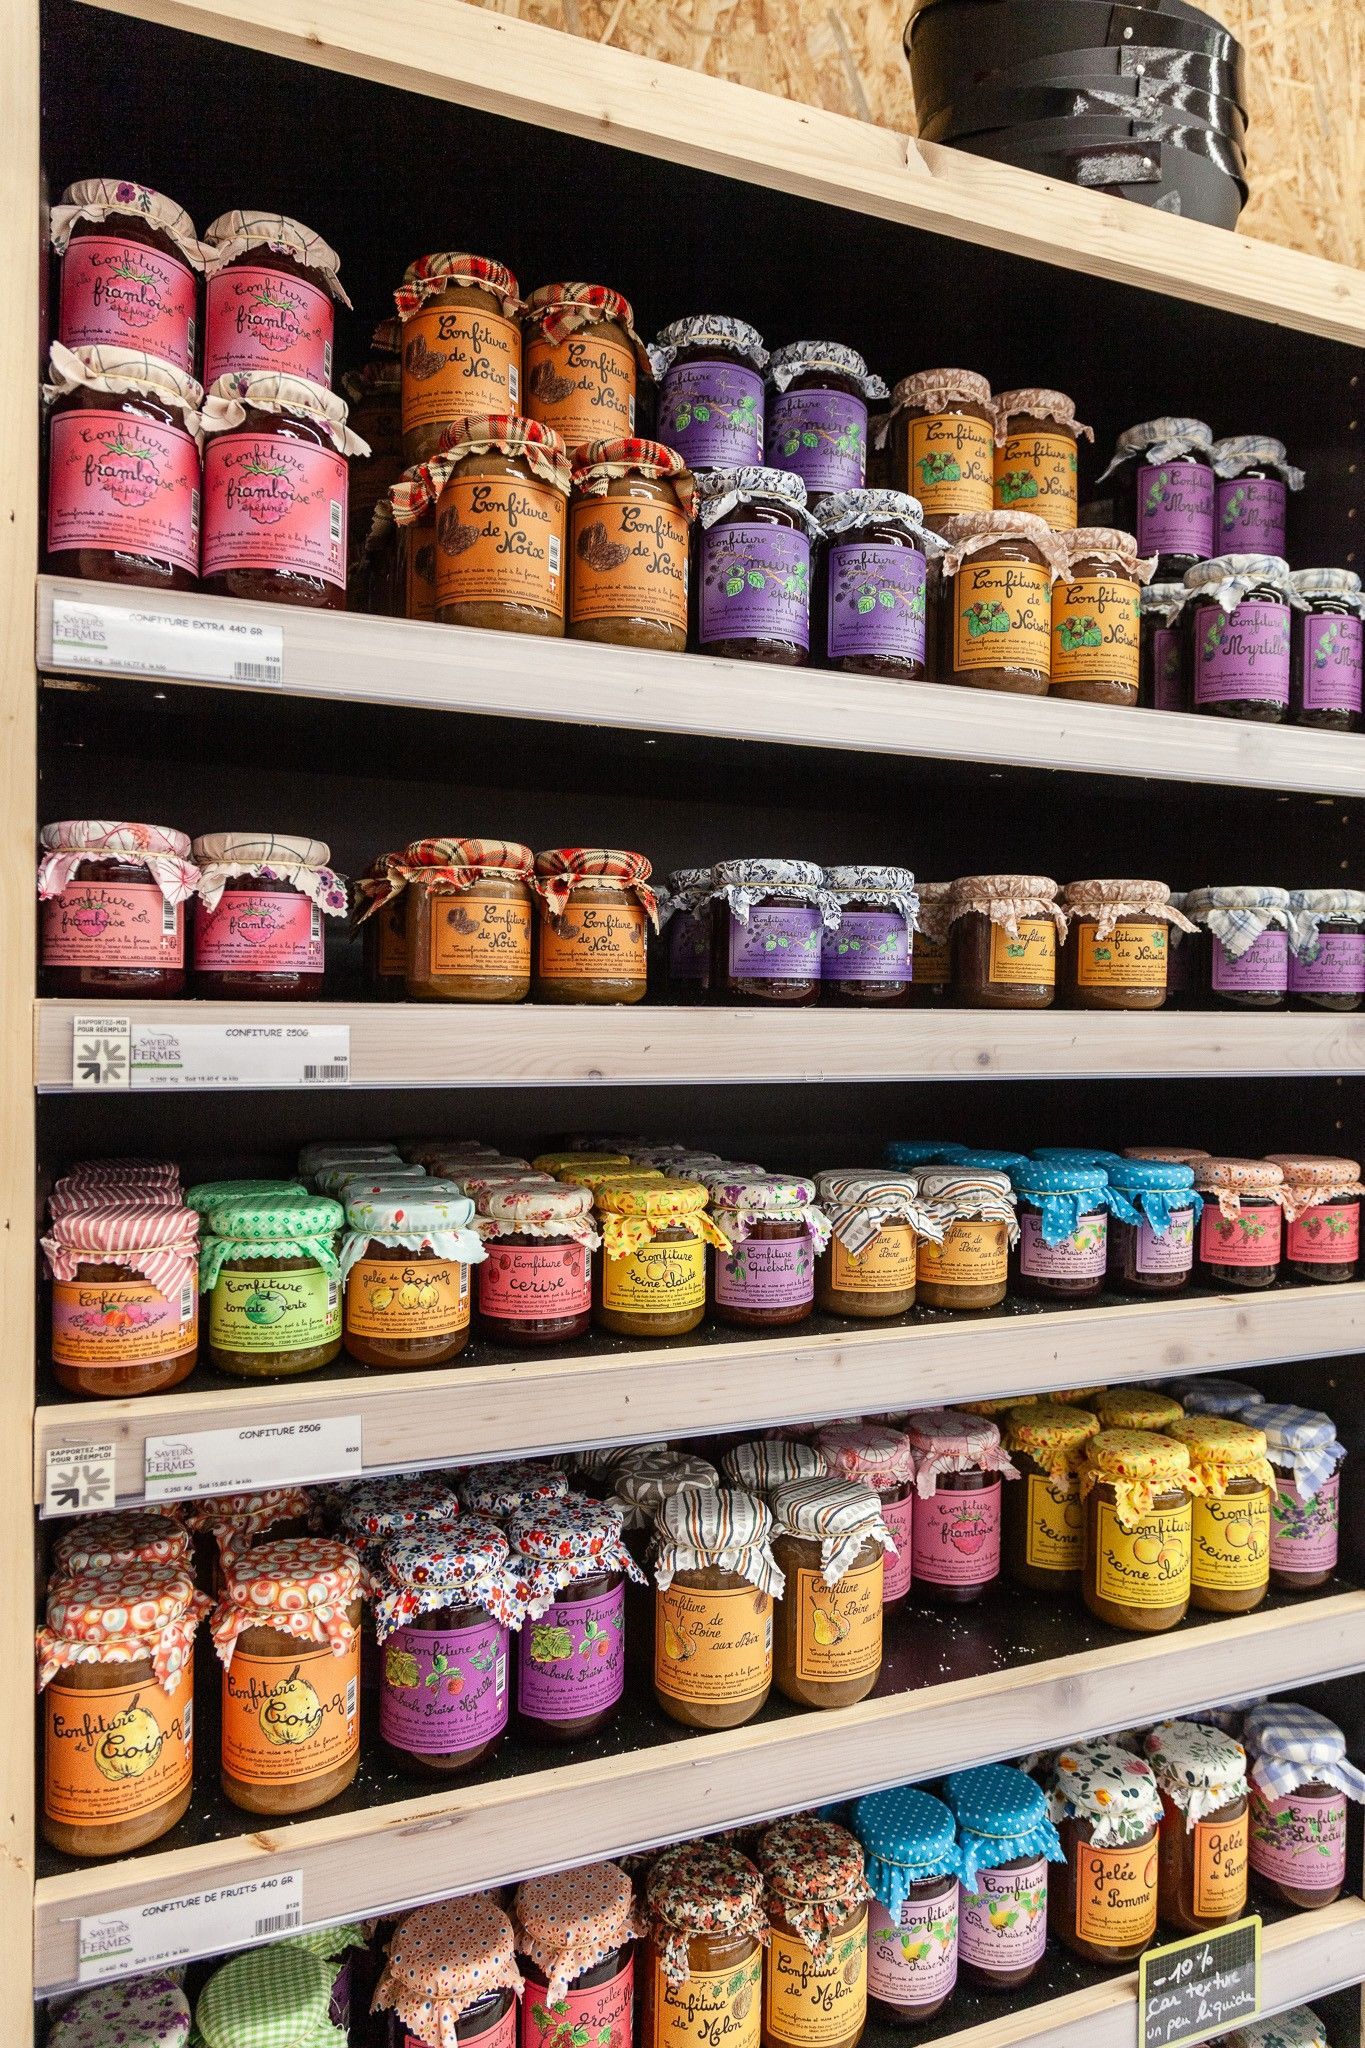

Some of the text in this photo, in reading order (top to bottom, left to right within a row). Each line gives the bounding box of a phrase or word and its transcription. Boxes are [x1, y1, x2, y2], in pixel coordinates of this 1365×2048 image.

[89, 250, 171, 284] Confiture
[93, 278, 175, 317] framboise
[232, 278, 309, 310] Confiture
[236, 306, 312, 340] framboise
[437, 315, 511, 353] Confiture
[448, 349, 506, 385] de Noix
[566, 344, 630, 383] Confiture
[577, 379, 628, 415] de Noix
[80, 423, 170, 457] Confiture
[925, 422, 989, 449] Confiture
[222, 443, 305, 472] Confiture
[1004, 442, 1068, 467] Confiture
[83, 454, 175, 491] framboise
[226, 476, 310, 509] framboise
[470, 485, 552, 527] Confiture
[619, 507, 686, 548] Confiture
[482, 521, 544, 560] de Noix
[706, 530, 768, 551] Confiture
[632, 544, 683, 581] de Noix
[836, 552, 898, 569] Confiture
[972, 570, 1044, 598] Confiture
[1027, 595, 1041, 605] de
[1065, 586, 1131, 613] Confiture
[63, 614, 105, 627] SAVEURS
[129, 613, 263, 636] CONFITURE EXTRA 440 GR
[1119, 611, 1131, 621] de
[55, 625, 106, 641] FERMES
[56, 888, 135, 911] Confiture
[226, 897, 283, 912] Confiture
[60, 916, 126, 936] framboise
[229, 918, 286, 938] framboise
[482, 904, 527, 931] Confiture
[581, 910, 633, 936] Confiture
[751, 915, 790, 929] Confiture
[477, 928, 517, 949] de Noix
[577, 933, 620, 952] de Noix
[1118, 950, 1131, 958] de
[140, 1037, 180, 1048] SAVEURS
[226, 1028, 309, 1038] CONFITURE 250G
[132, 1050, 182, 1062] FERMES
[633, 1248, 694, 1265] Confiture
[747, 1247, 793, 1265] Confiture
[879, 1249, 900, 1258] Poire
[959, 1241, 982, 1253] Poire
[513, 1254, 562, 1276] Confiture
[749, 1262, 795, 1279] Quetsche
[362, 1270, 388, 1287] gelée
[401, 1267, 451, 1286] Coing
[509, 1277, 566, 1293] cerise
[225, 1279, 304, 1300] Confiture
[79, 1290, 153, 1312] Confiture
[223, 1301, 307, 1314] tomate verte
[238, 1423, 321, 1440] CONFITURE 250G
[50, 1445, 112, 1456] RAPPORTEZ-MOI
[51, 1455, 72, 1463] POUR
[154, 1449, 193, 1458] SAVEURS
[147, 1459, 195, 1473] FERMES
[938, 1500, 992, 1516] Confiture
[941, 1523, 994, 1544] framboise
[662, 1592, 707, 1616] Confiture
[861, 1591, 871, 1601] de
[556, 1607, 615, 1629] Confiture
[844, 1602, 870, 1616] Poire
[689, 1621, 722, 1639] Poire
[709, 1617, 723, 1626] de
[404, 1637, 491, 1666] Confiture de
[709, 1640, 732, 1650] aux
[227, 1676, 298, 1705] Confiture
[242, 1704, 255, 1714] de
[264, 1692, 345, 1727] Coing
[54, 1712, 137, 1741] Confiture
[74, 1741, 89, 1753] de
[101, 1717, 183, 1761] Coing
[1210, 1834, 1244, 1865] Gelée
[1090, 1858, 1137, 1891] Gelée
[1210, 1871, 1220, 1880] de
[141, 1876, 294, 1917] CONFITURE DE FRUITS 440 GR
[983, 1873, 1044, 1901] Confiture
[1091, 1888, 1151, 1908] de Pomme
[90, 1924, 129, 1938] SAVEURS
[81, 1935, 131, 1954] FERMES
[778, 1950, 839, 1989] Confiture
[665, 1985, 728, 2022] Confiture
[784, 1983, 802, 1996] de
[811, 1982, 854, 2011] Melon
[1147, 1991, 1255, 2040] un peu liquide
[671, 2016, 744, 2047] de Melon
